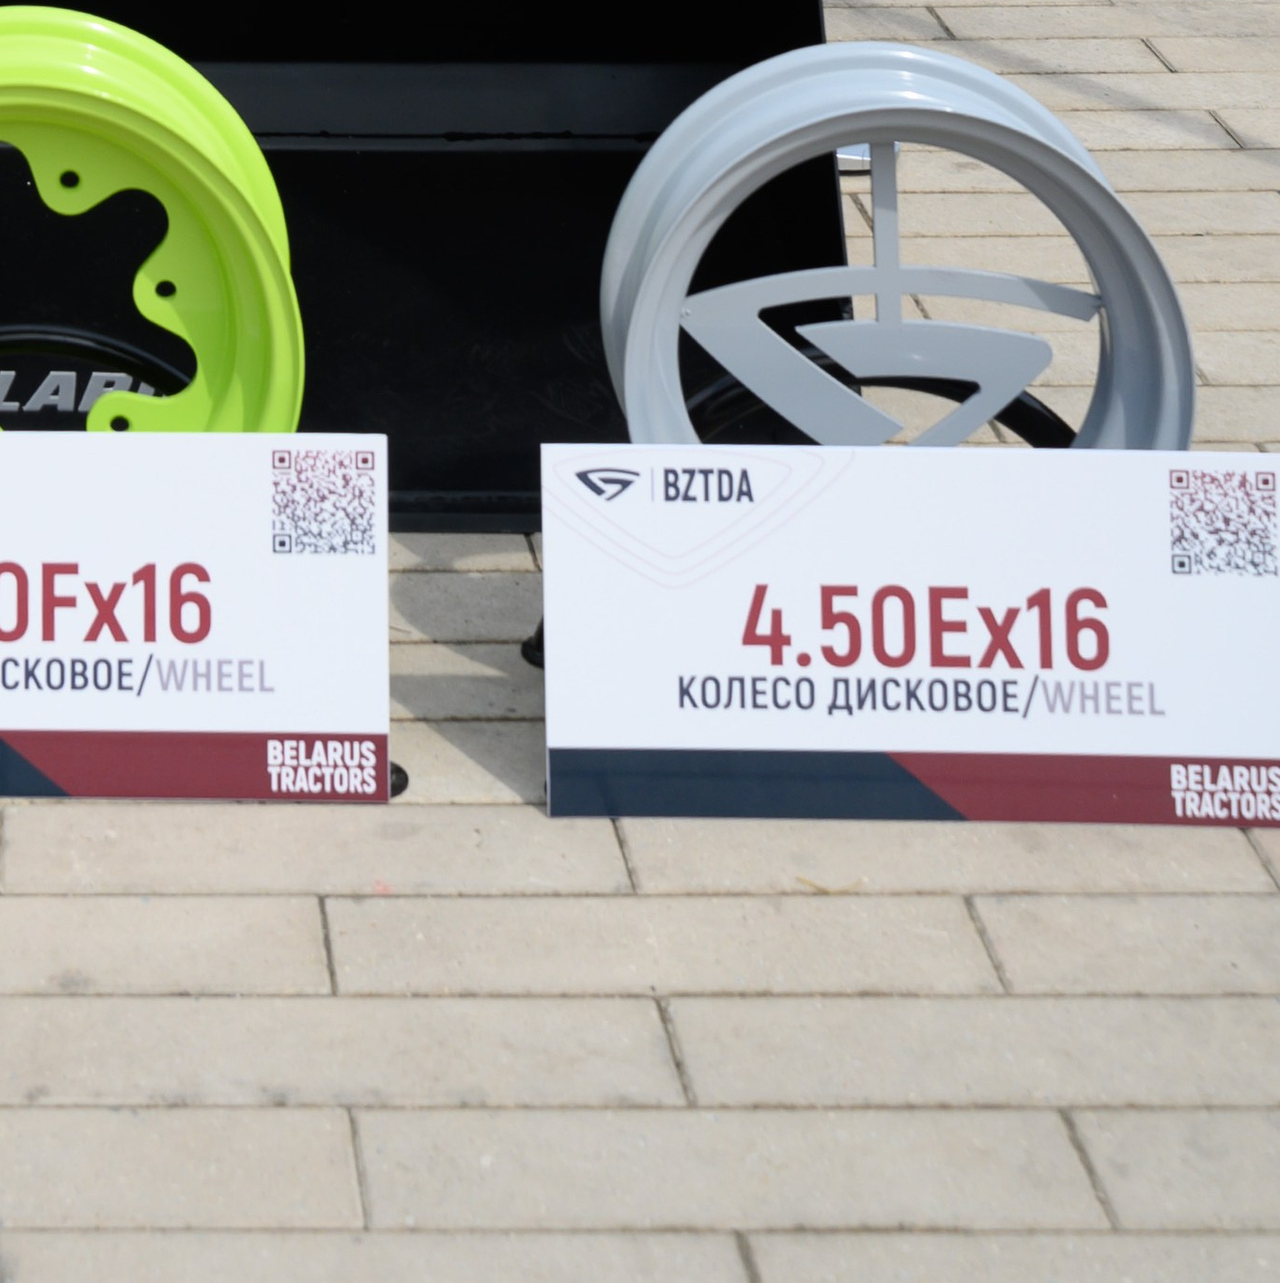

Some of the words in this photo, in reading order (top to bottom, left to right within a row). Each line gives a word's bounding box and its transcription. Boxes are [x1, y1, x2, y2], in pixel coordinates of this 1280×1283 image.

[663, 467, 754, 504] BZTDA
[741, 583, 1111, 672] 4.50Ex16
[677, 675, 816, 712] КОЛЕСО
[827, 673, 1166, 719] ДИСКОВОЕ/WHEEL
[267, 739, 376, 769] BELARUS
[267, 765, 377, 795] TRACTORS
[1170, 764, 1280, 792] BELARUS
[1171, 790, 1280, 821] TRACTORS
